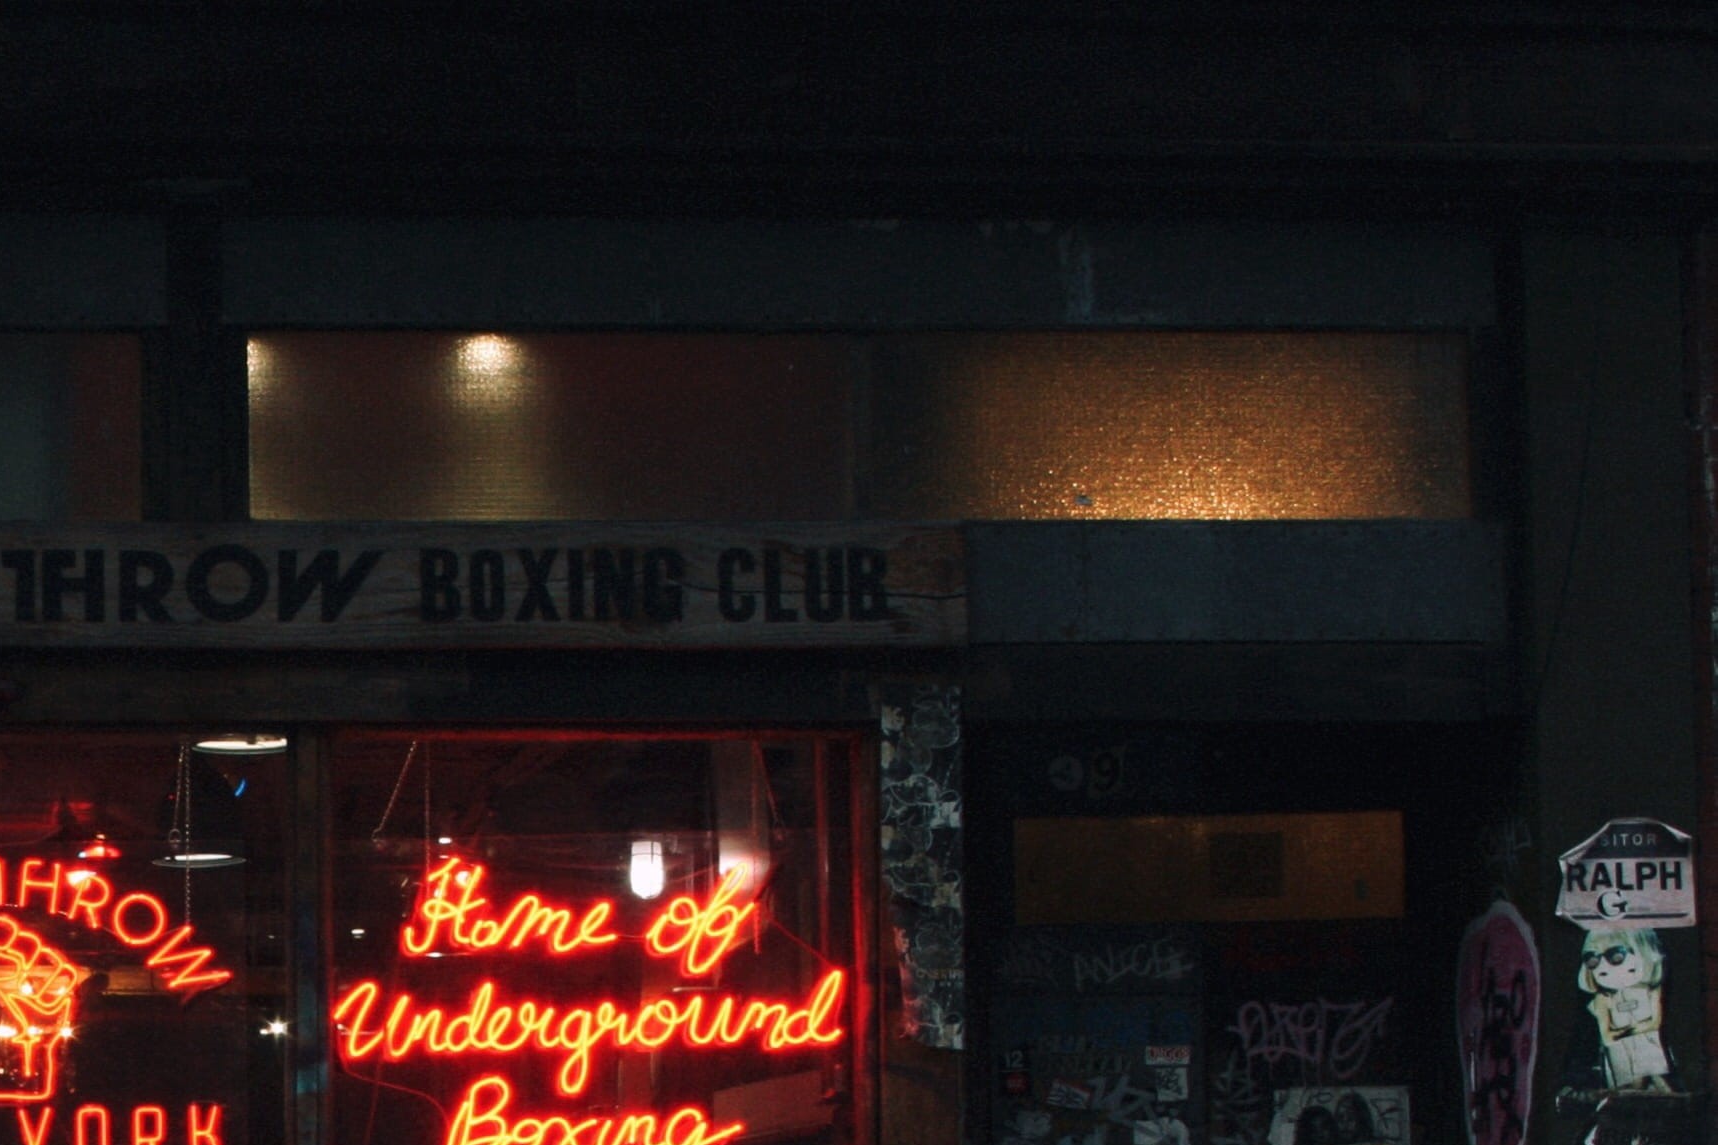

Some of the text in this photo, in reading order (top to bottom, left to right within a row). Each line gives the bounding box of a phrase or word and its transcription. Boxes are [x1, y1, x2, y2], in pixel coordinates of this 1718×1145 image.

[420, 548, 684, 623] BOXING
[718, 547, 889, 623] CLUB
[402, 857, 758, 976] Home of
[1567, 862, 1682, 892] RALPH
[334, 969, 845, 1097] Underground
